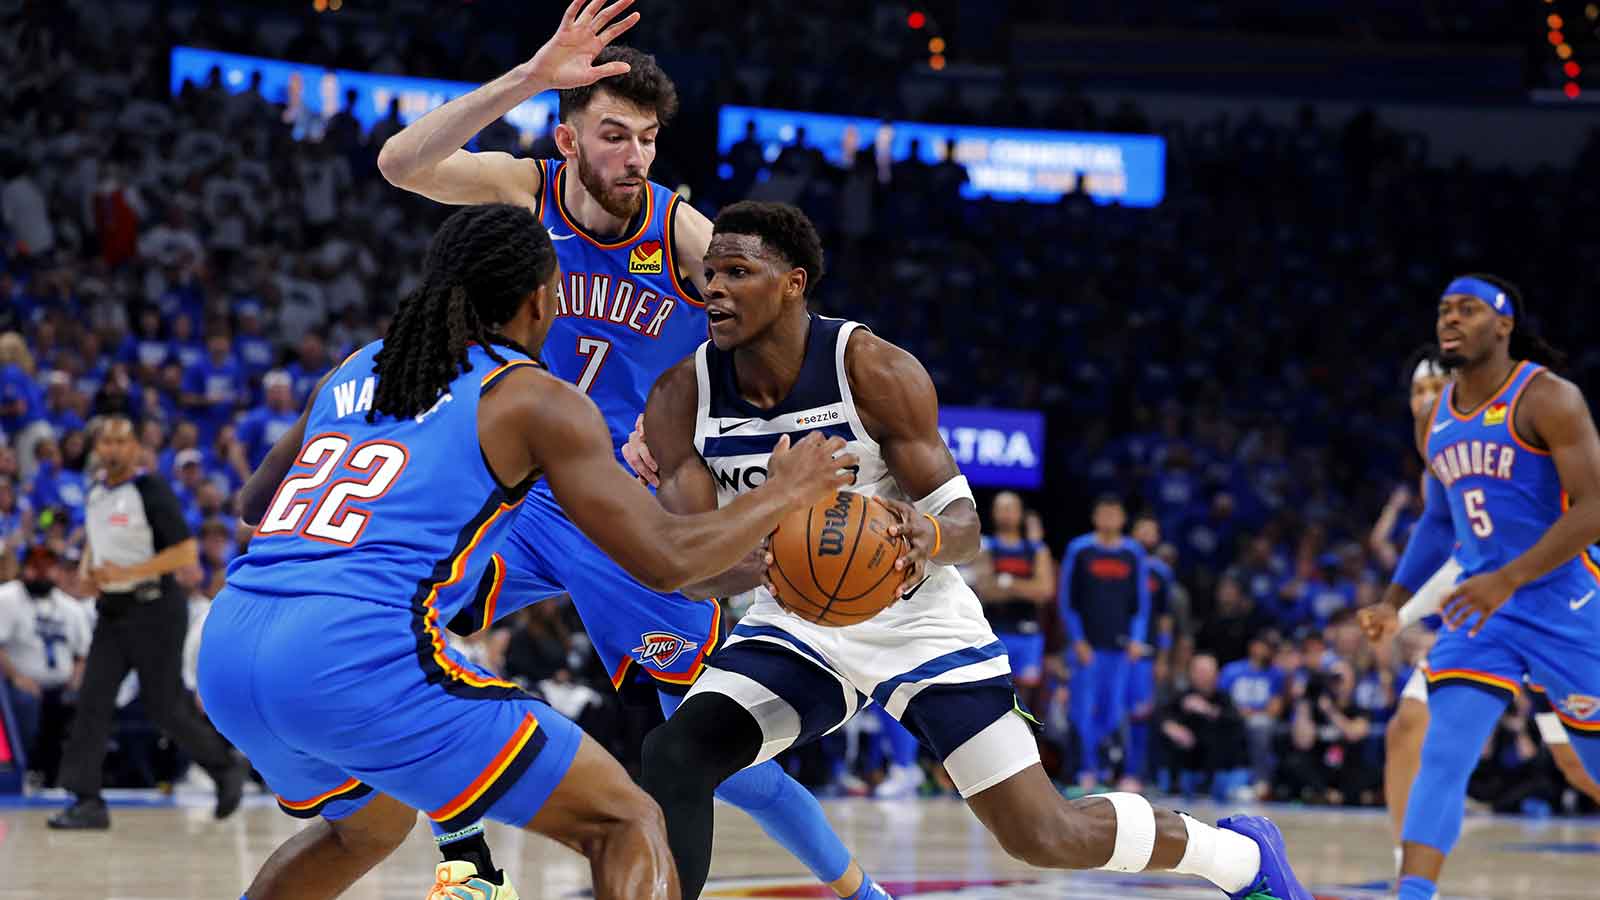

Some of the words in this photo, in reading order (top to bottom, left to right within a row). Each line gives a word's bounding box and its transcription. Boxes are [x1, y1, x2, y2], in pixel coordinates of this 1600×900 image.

[554, 272, 677, 339] HUNDER
[576, 336, 612, 393] 7
[804, 410, 839, 424] sezzle
[255, 432, 410, 547] 22
[1431, 440, 1515, 487] HUNDER
[1463, 488, 1494, 538] 5
